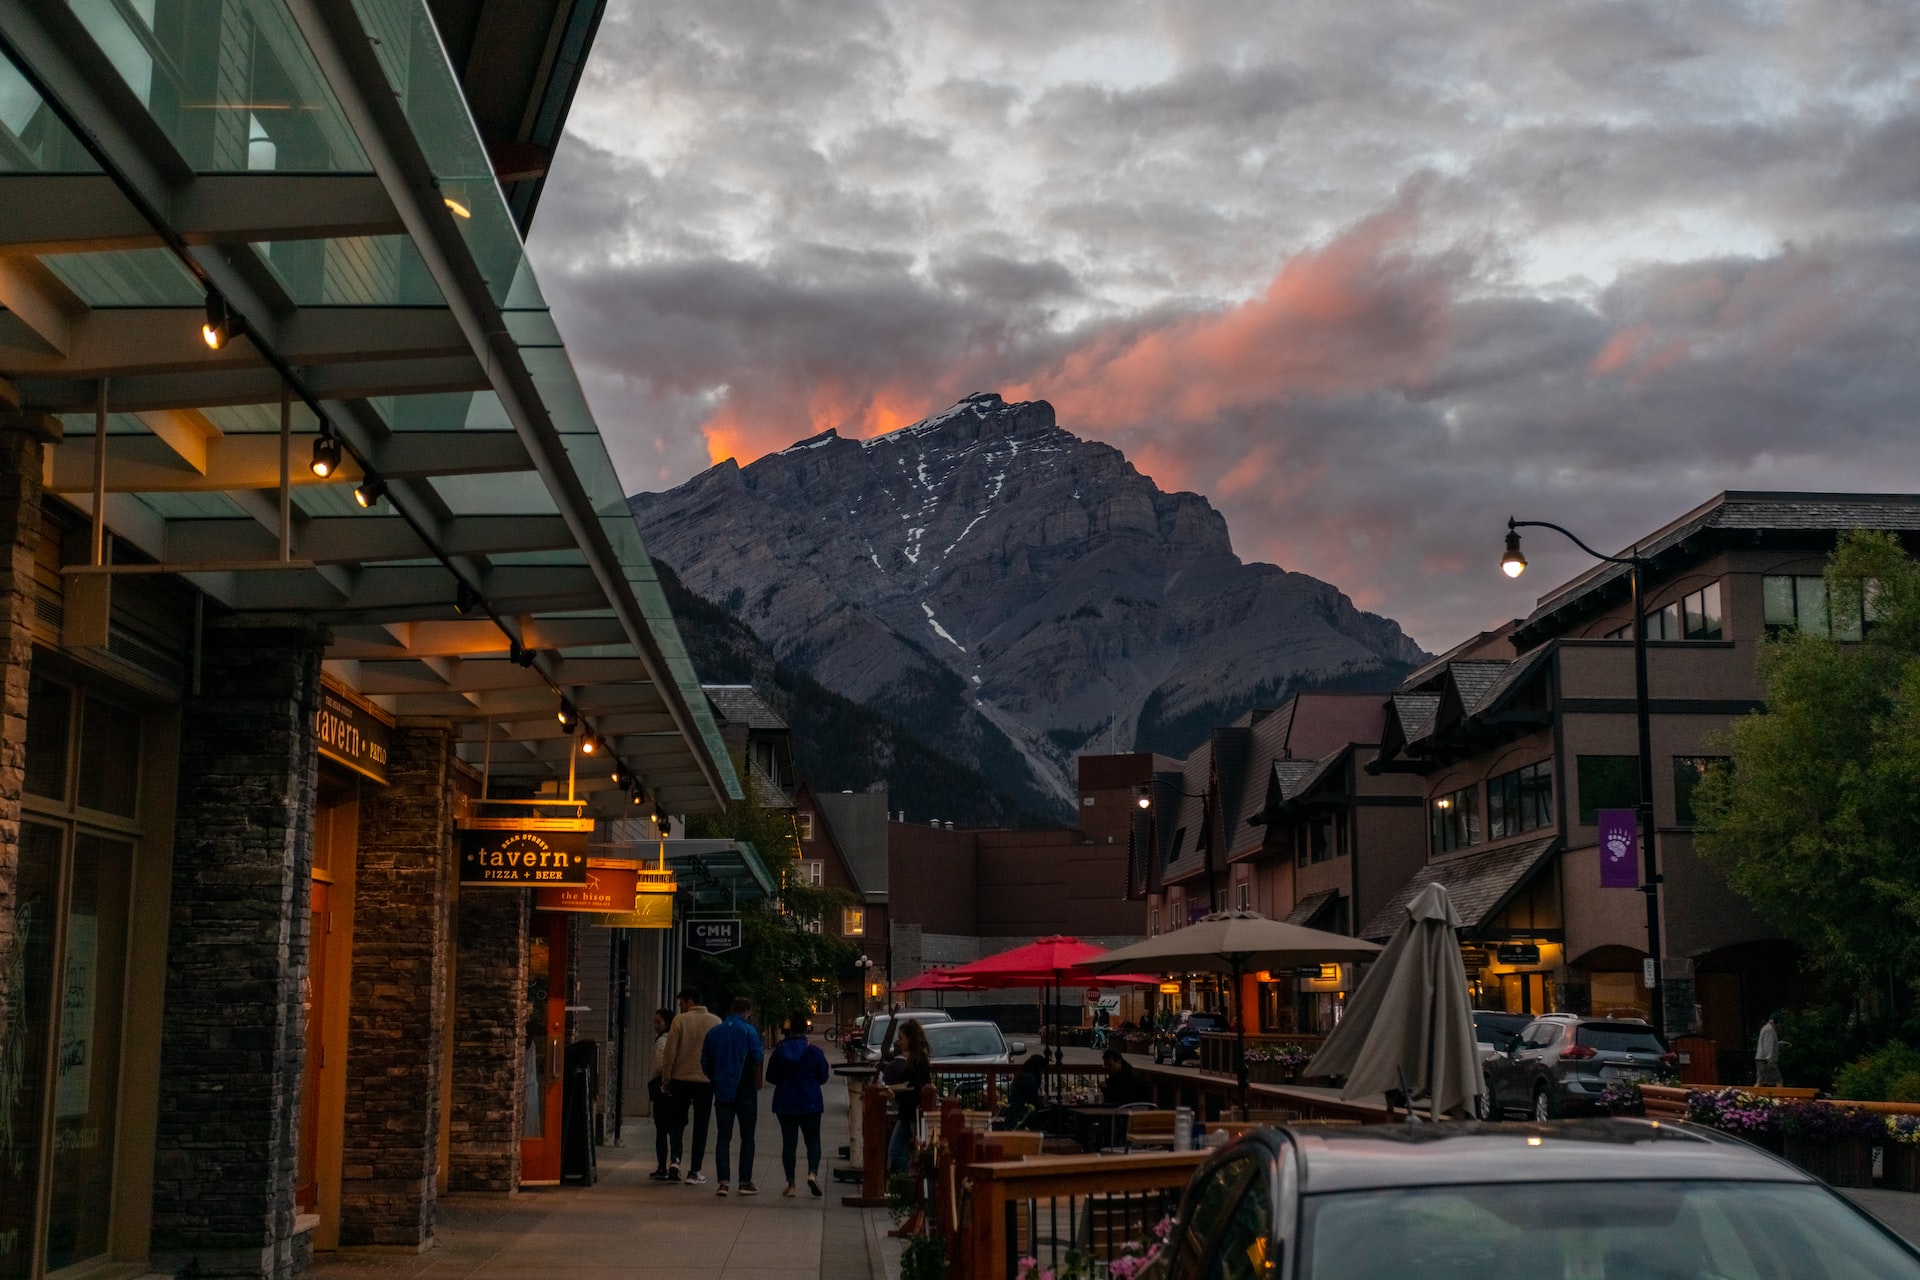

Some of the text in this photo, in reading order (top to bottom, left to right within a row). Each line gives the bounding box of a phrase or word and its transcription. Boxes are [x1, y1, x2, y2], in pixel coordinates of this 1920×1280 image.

[501, 833, 549, 851] BEAR STREET
[478, 847, 569, 868] tavern
[484, 871, 519, 879] PIZZA
[535, 871, 563, 880] BEER
[561, 891, 611, 902] the bison
[696, 925, 732, 937] CMH
[1086, 990, 1100, 998] STOP
